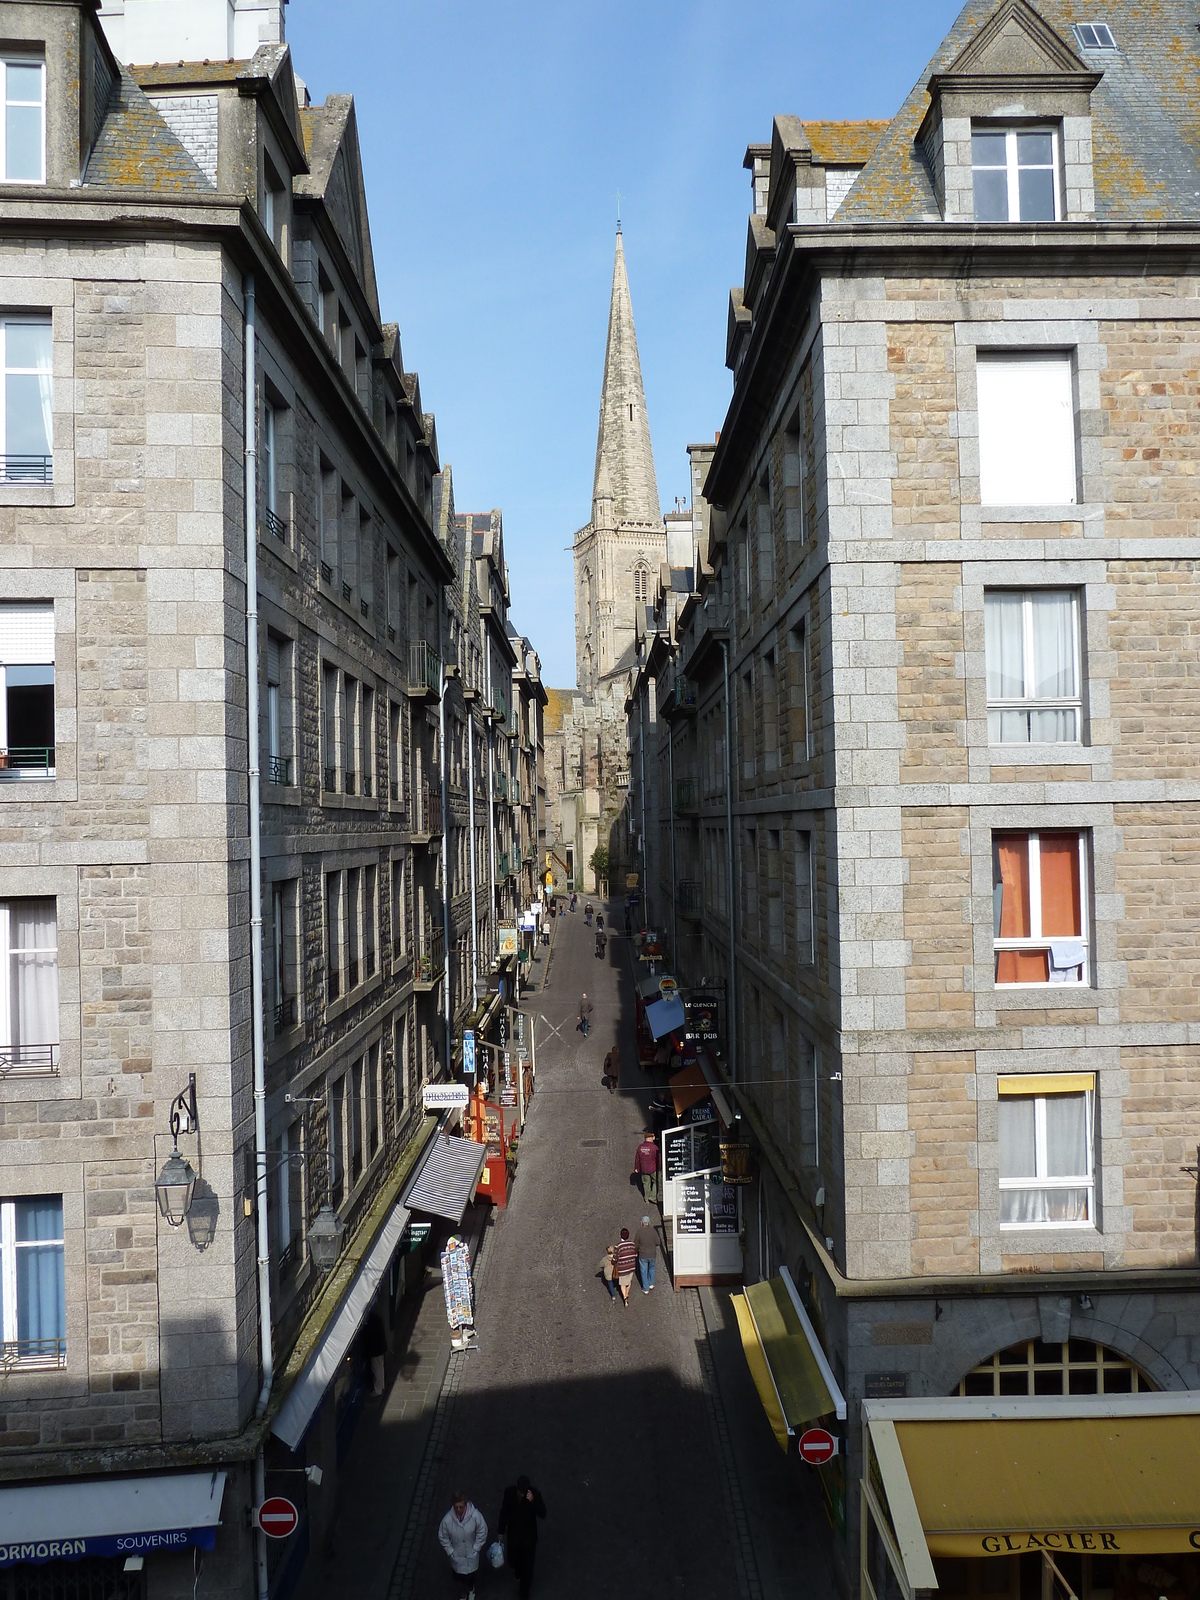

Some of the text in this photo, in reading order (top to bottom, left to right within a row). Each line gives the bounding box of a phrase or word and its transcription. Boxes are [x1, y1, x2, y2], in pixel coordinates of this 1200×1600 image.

[703, 1032, 718, 1040] PUB
[713, 1203, 736, 1214] PUB
[116, 1532, 188, 1550] SOUVENIRS
[981, 1532, 1121, 1553] GLACIER
